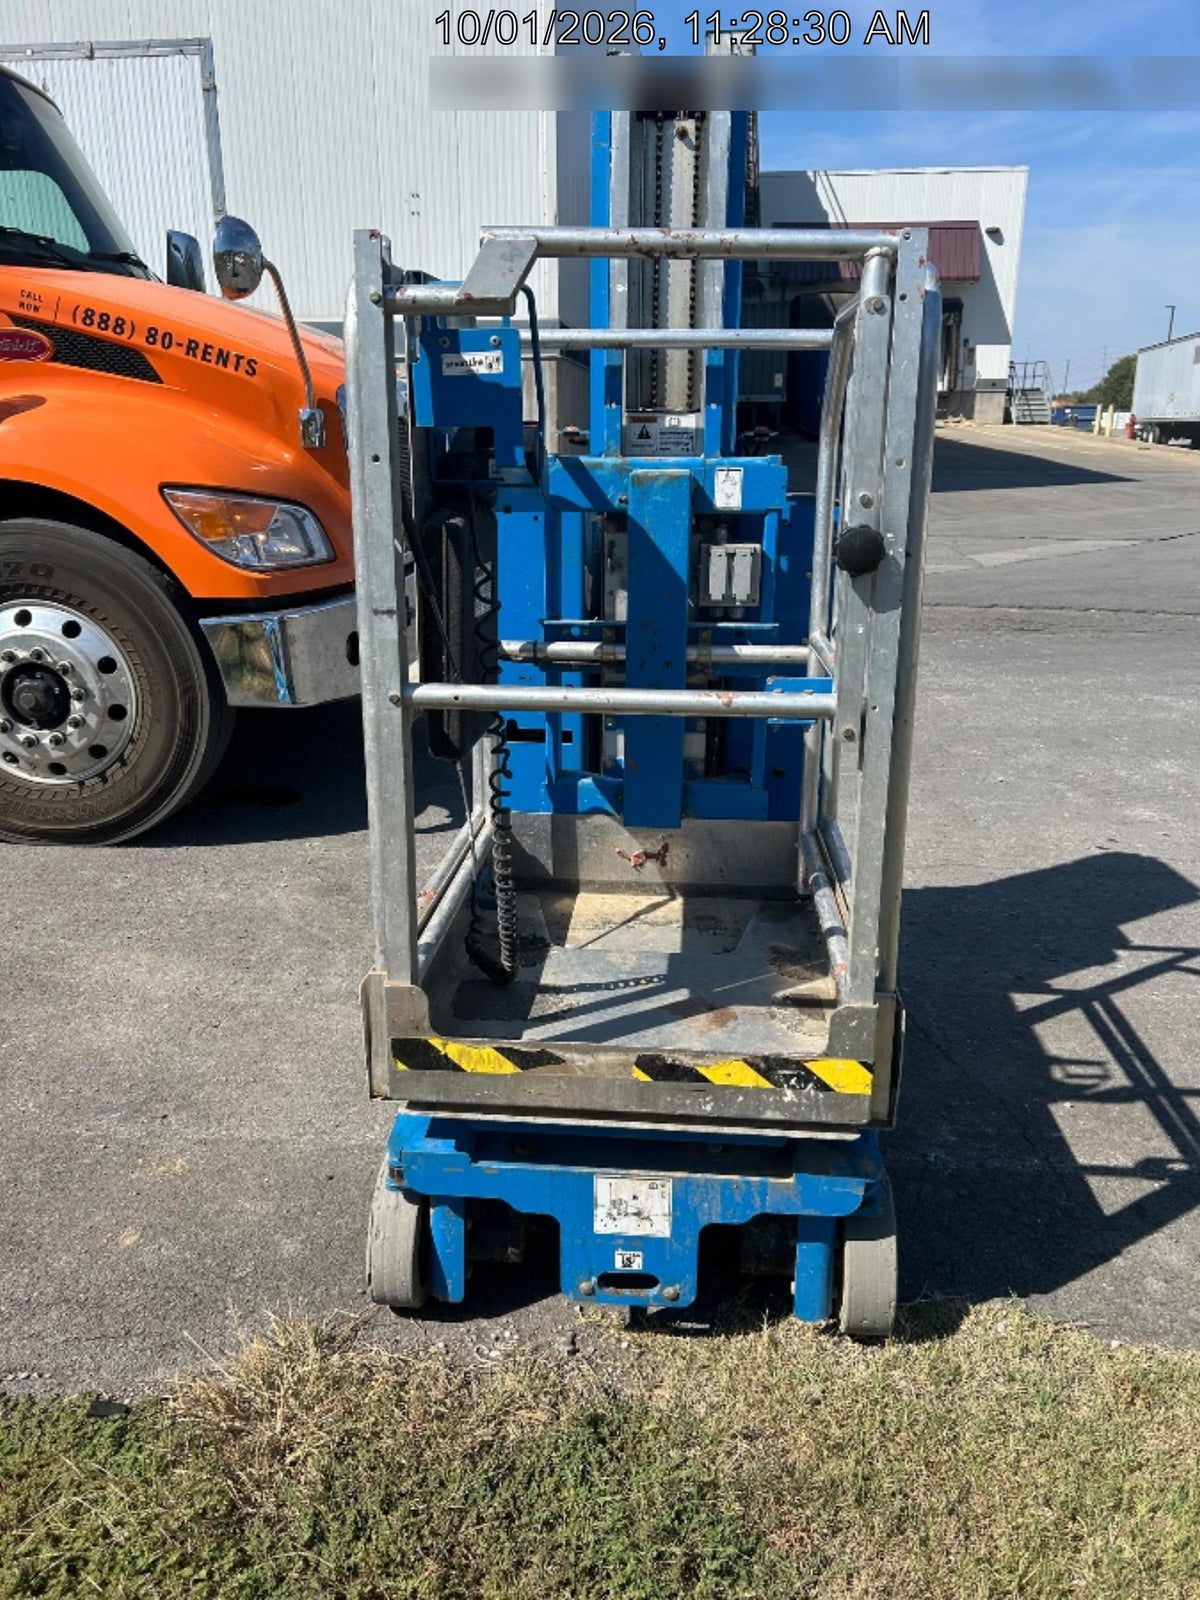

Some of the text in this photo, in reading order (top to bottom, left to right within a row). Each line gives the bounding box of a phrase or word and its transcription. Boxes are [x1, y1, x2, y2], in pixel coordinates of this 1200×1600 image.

[20, 289, 43, 303] CALL
[18, 301, 41, 313] NOW
[71, 304, 259, 377] (888) 80-RENTS
